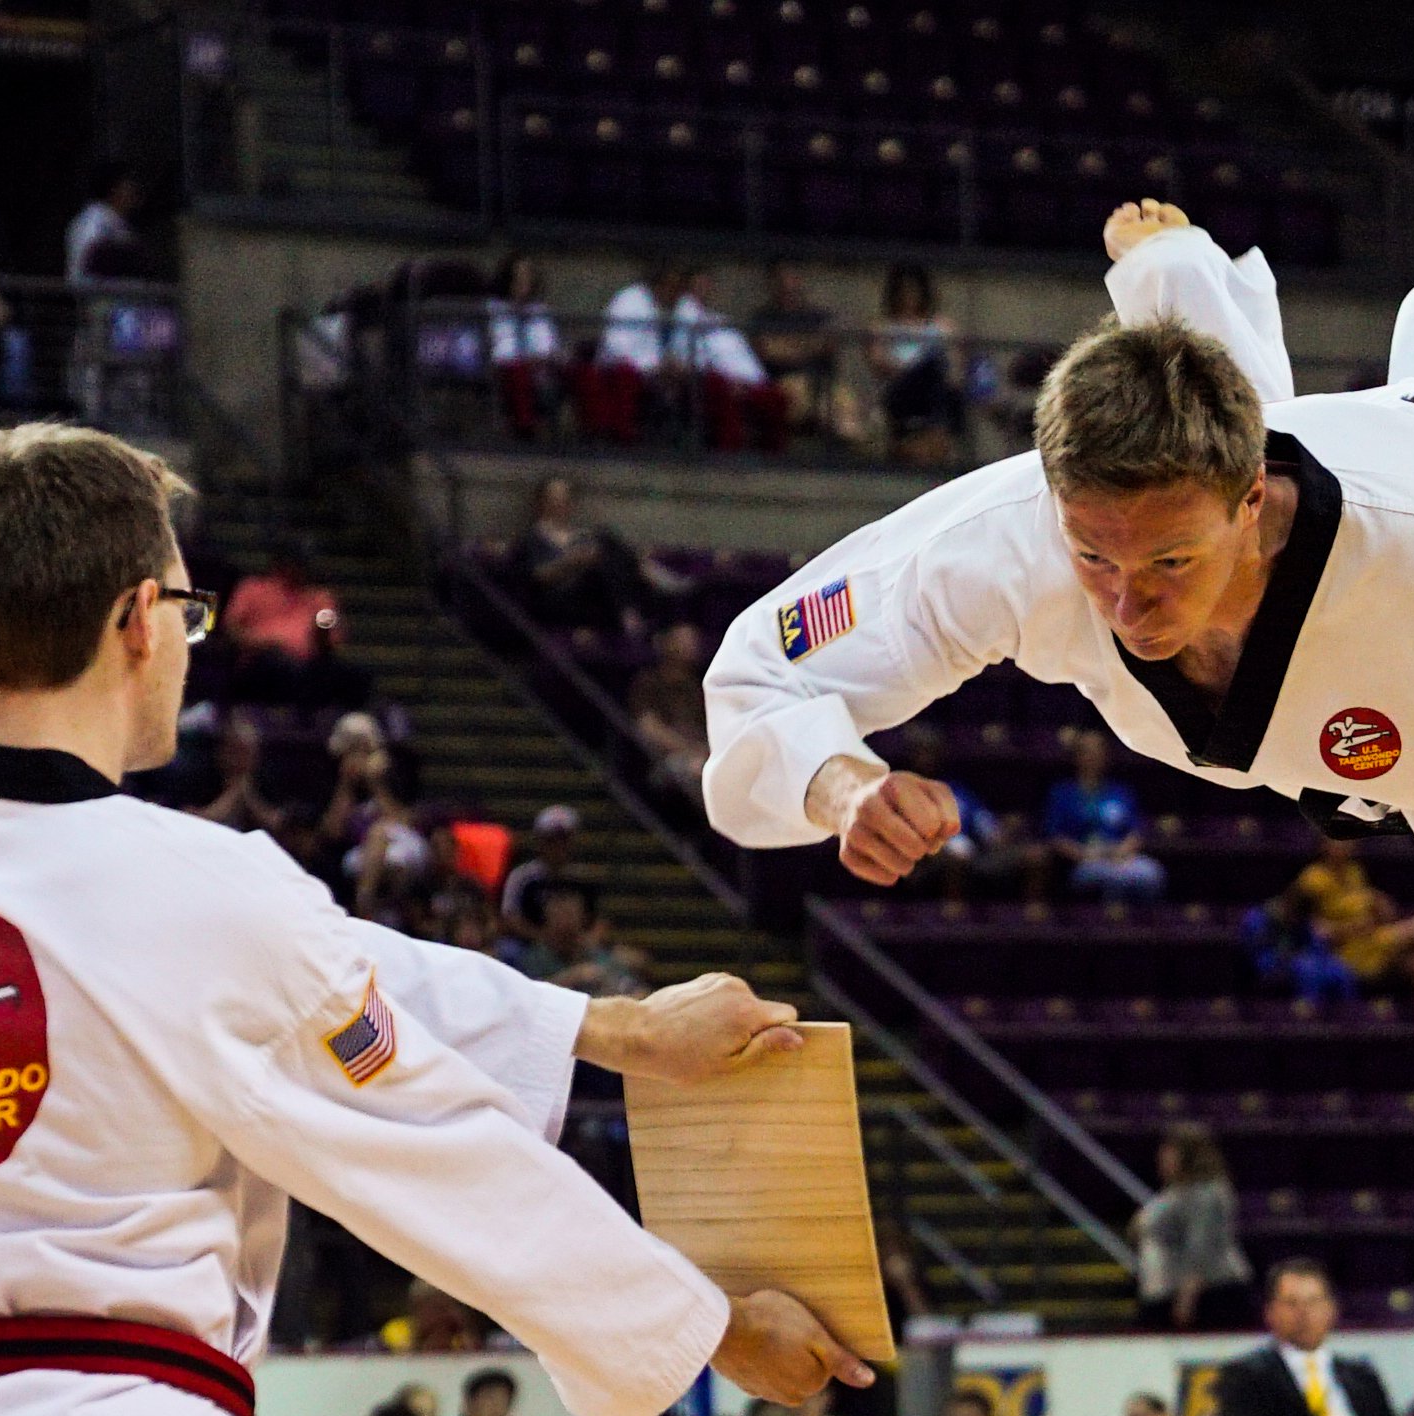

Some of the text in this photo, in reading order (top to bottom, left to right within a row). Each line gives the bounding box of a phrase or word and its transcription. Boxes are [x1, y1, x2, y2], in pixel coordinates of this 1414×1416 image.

[1361, 744, 1382, 755] U.S.
[1338, 749, 1400, 766] TAEKWONDO
[1353, 757, 1393, 771] CENTER
